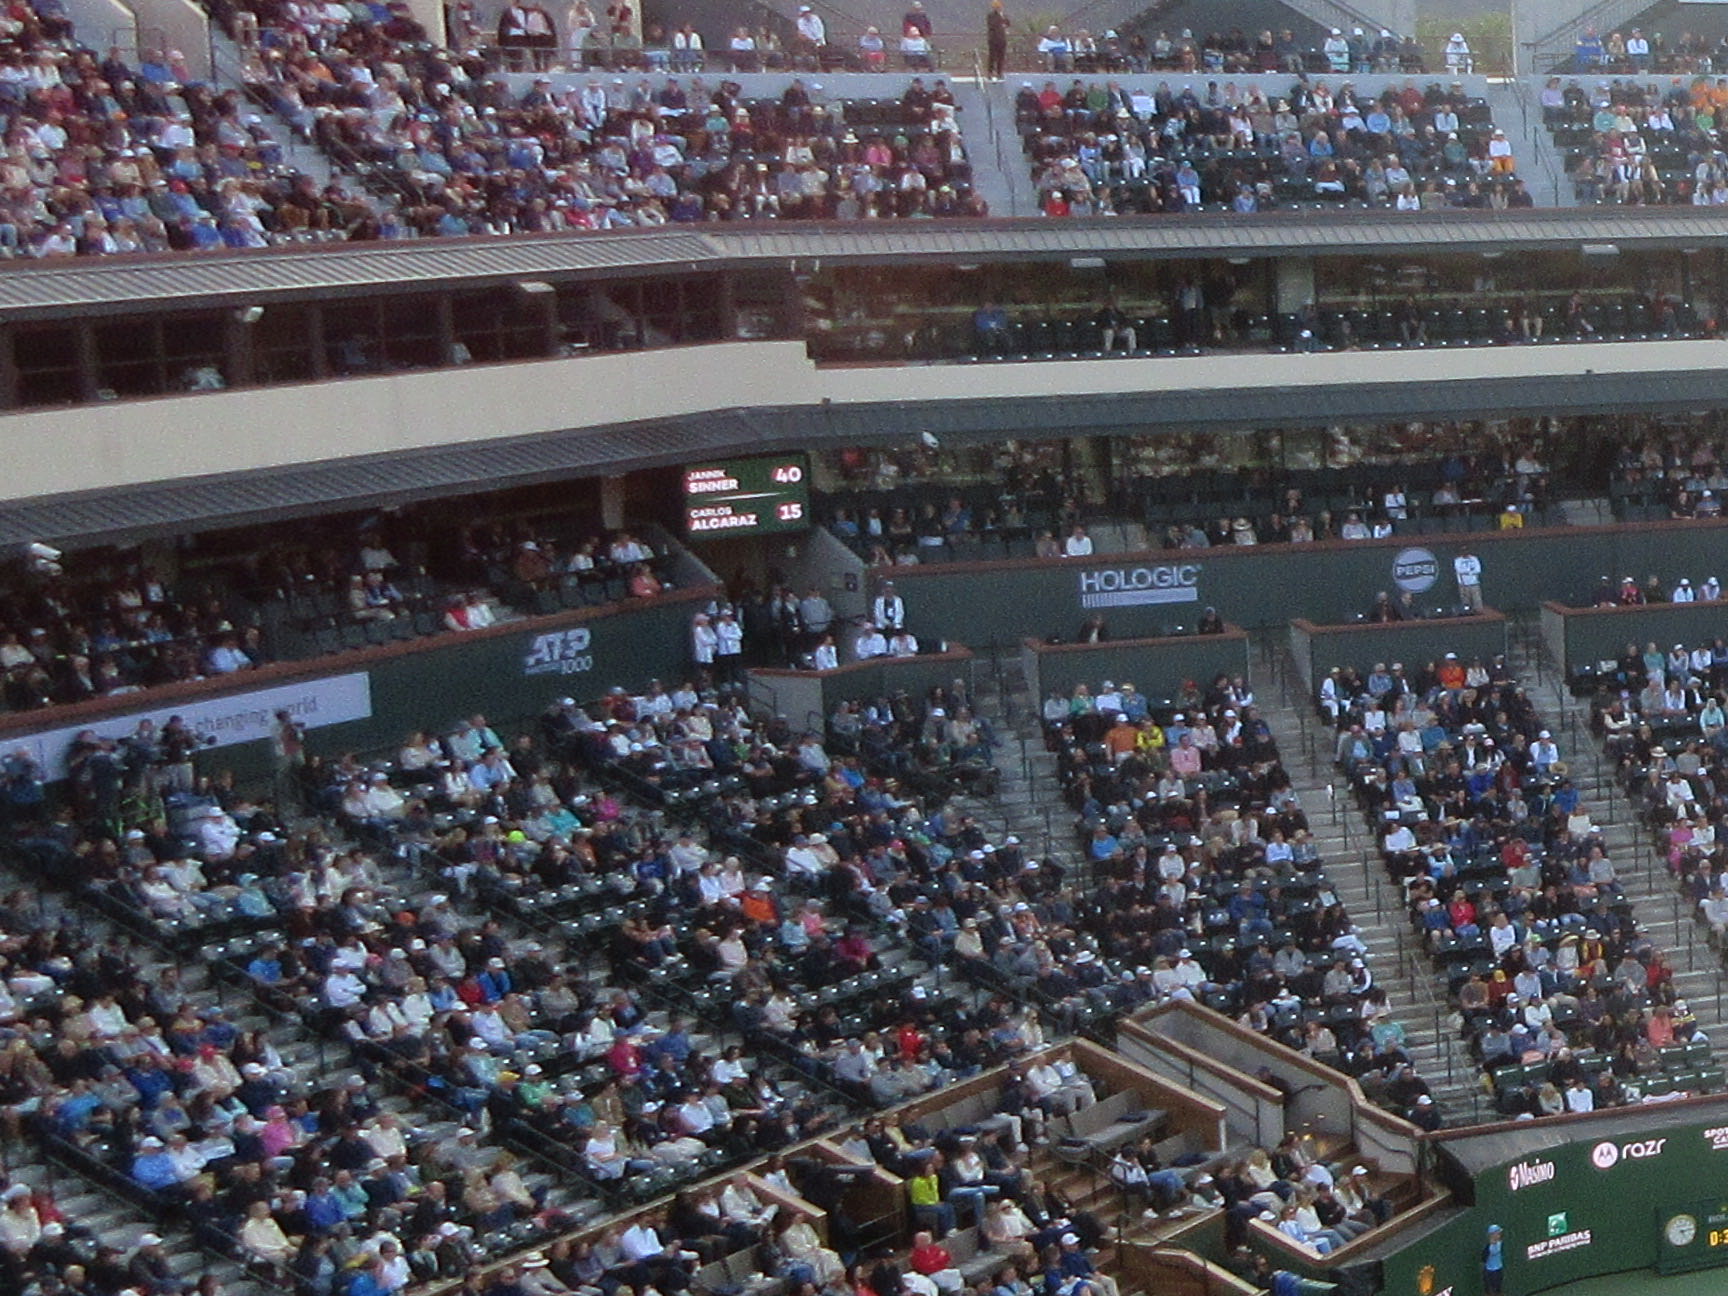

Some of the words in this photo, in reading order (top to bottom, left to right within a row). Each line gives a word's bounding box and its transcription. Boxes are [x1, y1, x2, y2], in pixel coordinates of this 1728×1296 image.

[775, 466, 802, 483] 40
[688, 479, 739, 494] SINNER
[690, 506, 733, 519] CARLOS
[691, 514, 758, 532] ALCARAZ
[779, 504, 802, 520] 15
[1080, 565, 1198, 592] HOLOGIC
[1396, 564, 1435, 576] PEPSI
[525, 627, 591, 665] ATP
[561, 655, 593, 675] 1000
[1622, 1138, 1667, 1160] razr
[1527, 1241, 1548, 1256] BNP
[1549, 1229, 1591, 1250] PARIBAS
